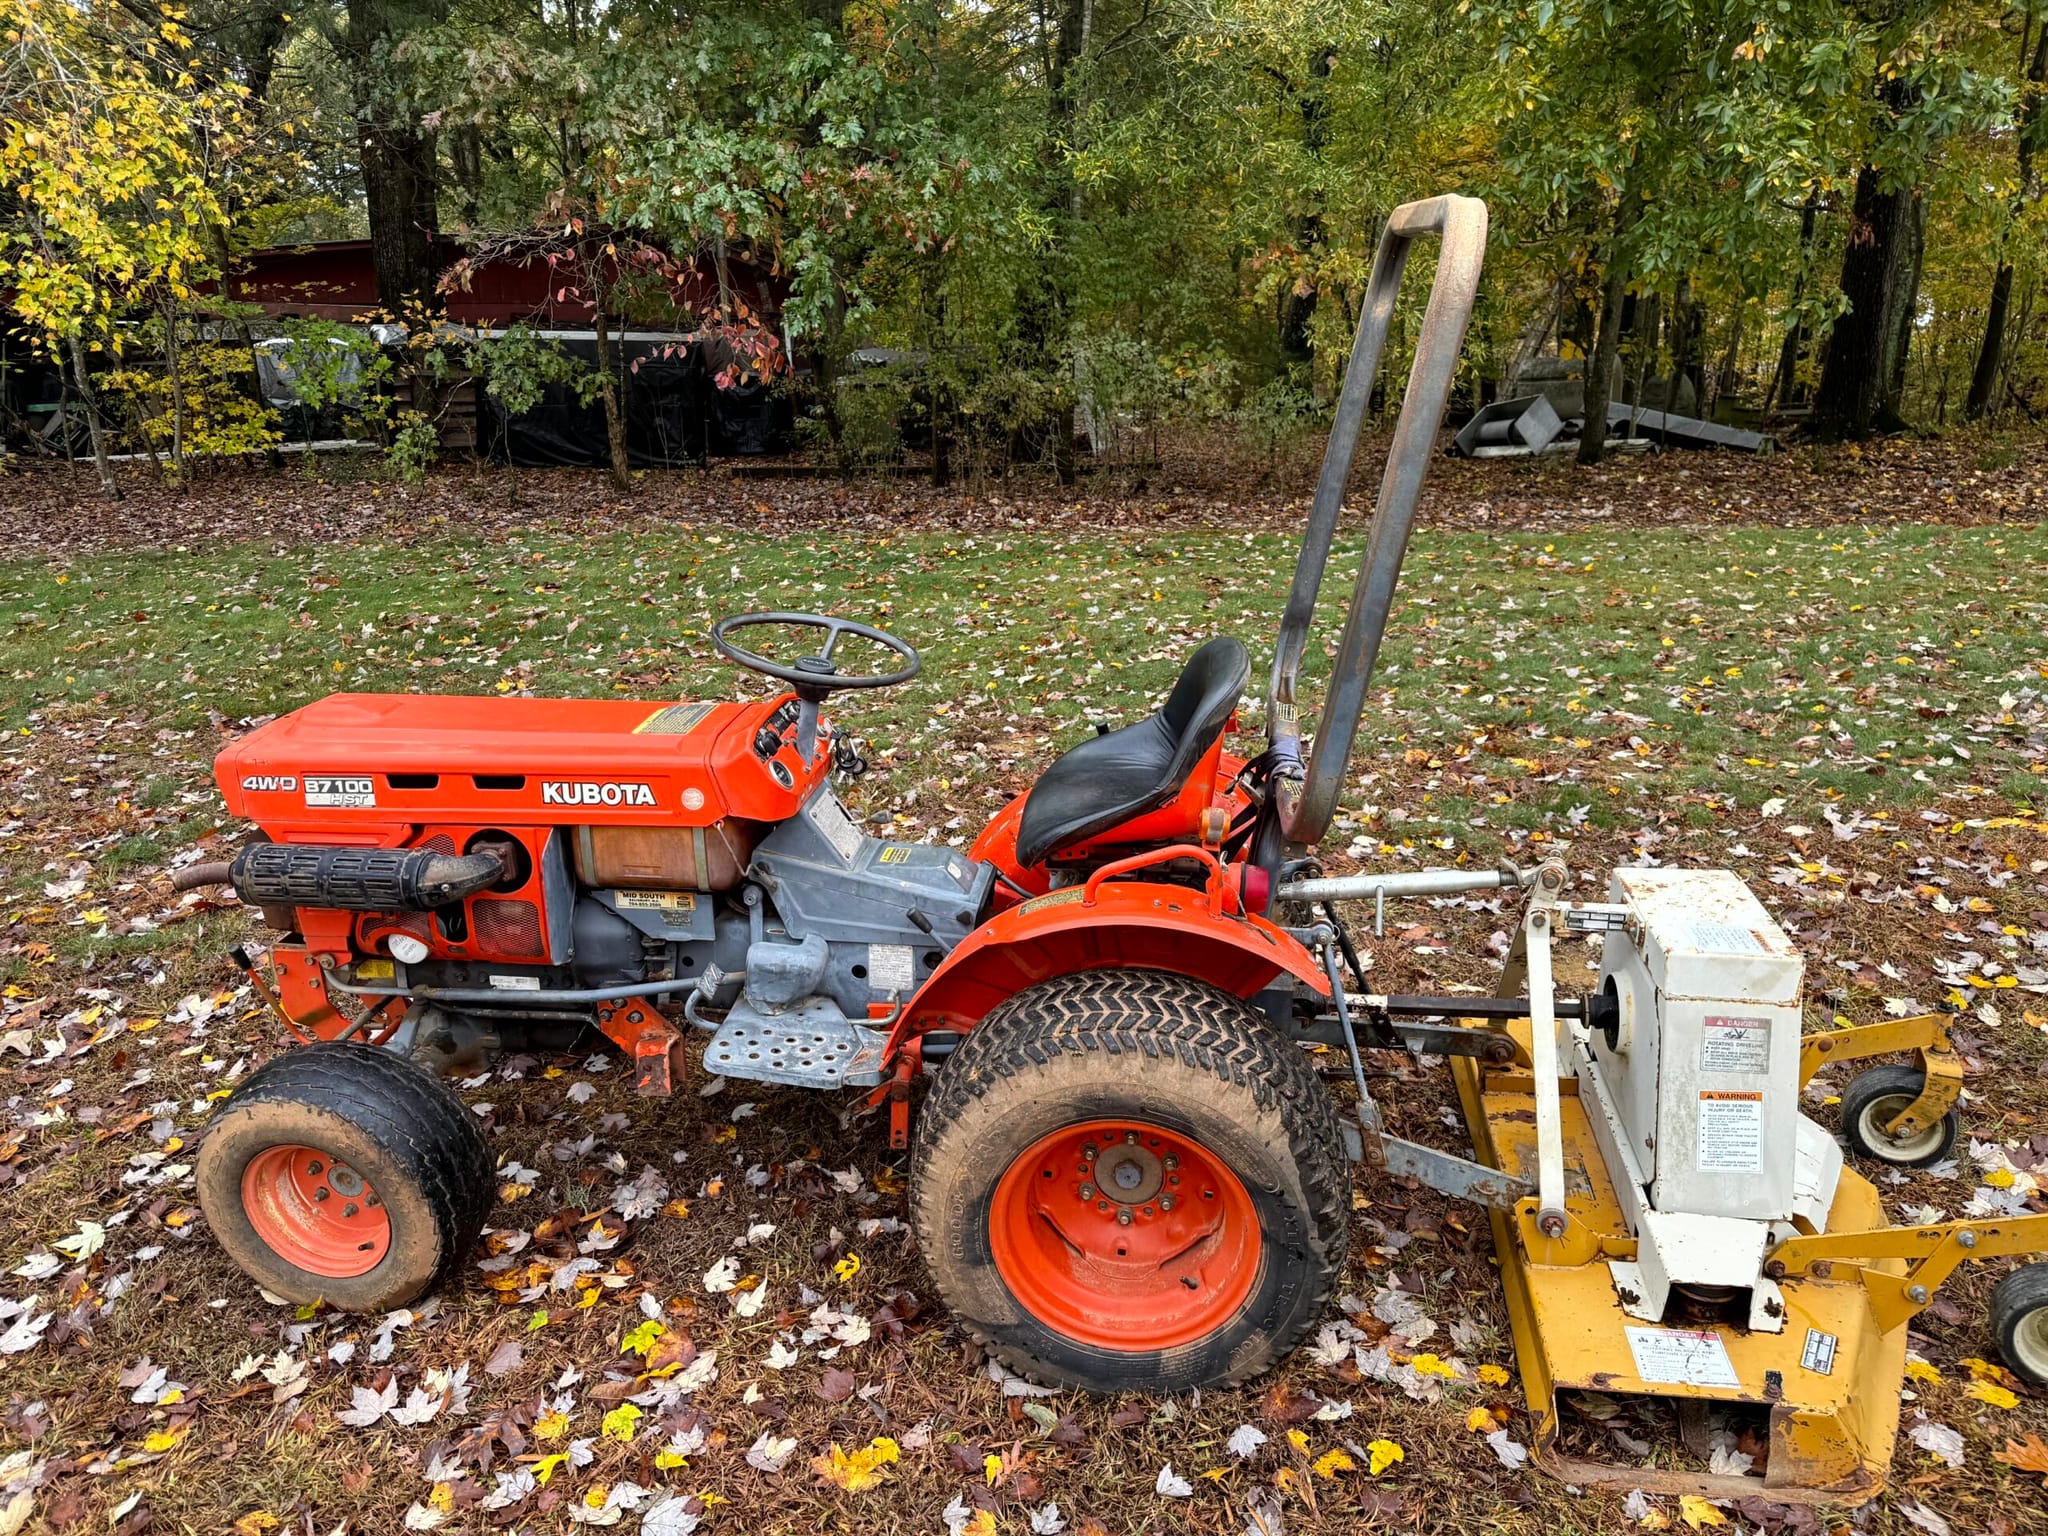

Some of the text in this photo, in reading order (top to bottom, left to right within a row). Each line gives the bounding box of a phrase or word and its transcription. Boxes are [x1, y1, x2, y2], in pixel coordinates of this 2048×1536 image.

[243, 776, 298, 791] 4WD
[304, 780, 373, 793] B7100
[330, 793, 369, 805] HST
[541, 781, 658, 806] KUBOTA
[639, 892, 666, 900] SOUTH
[1727, 1019, 1759, 1028] DANGER
[1717, 1093, 1757, 1101] WARNING
